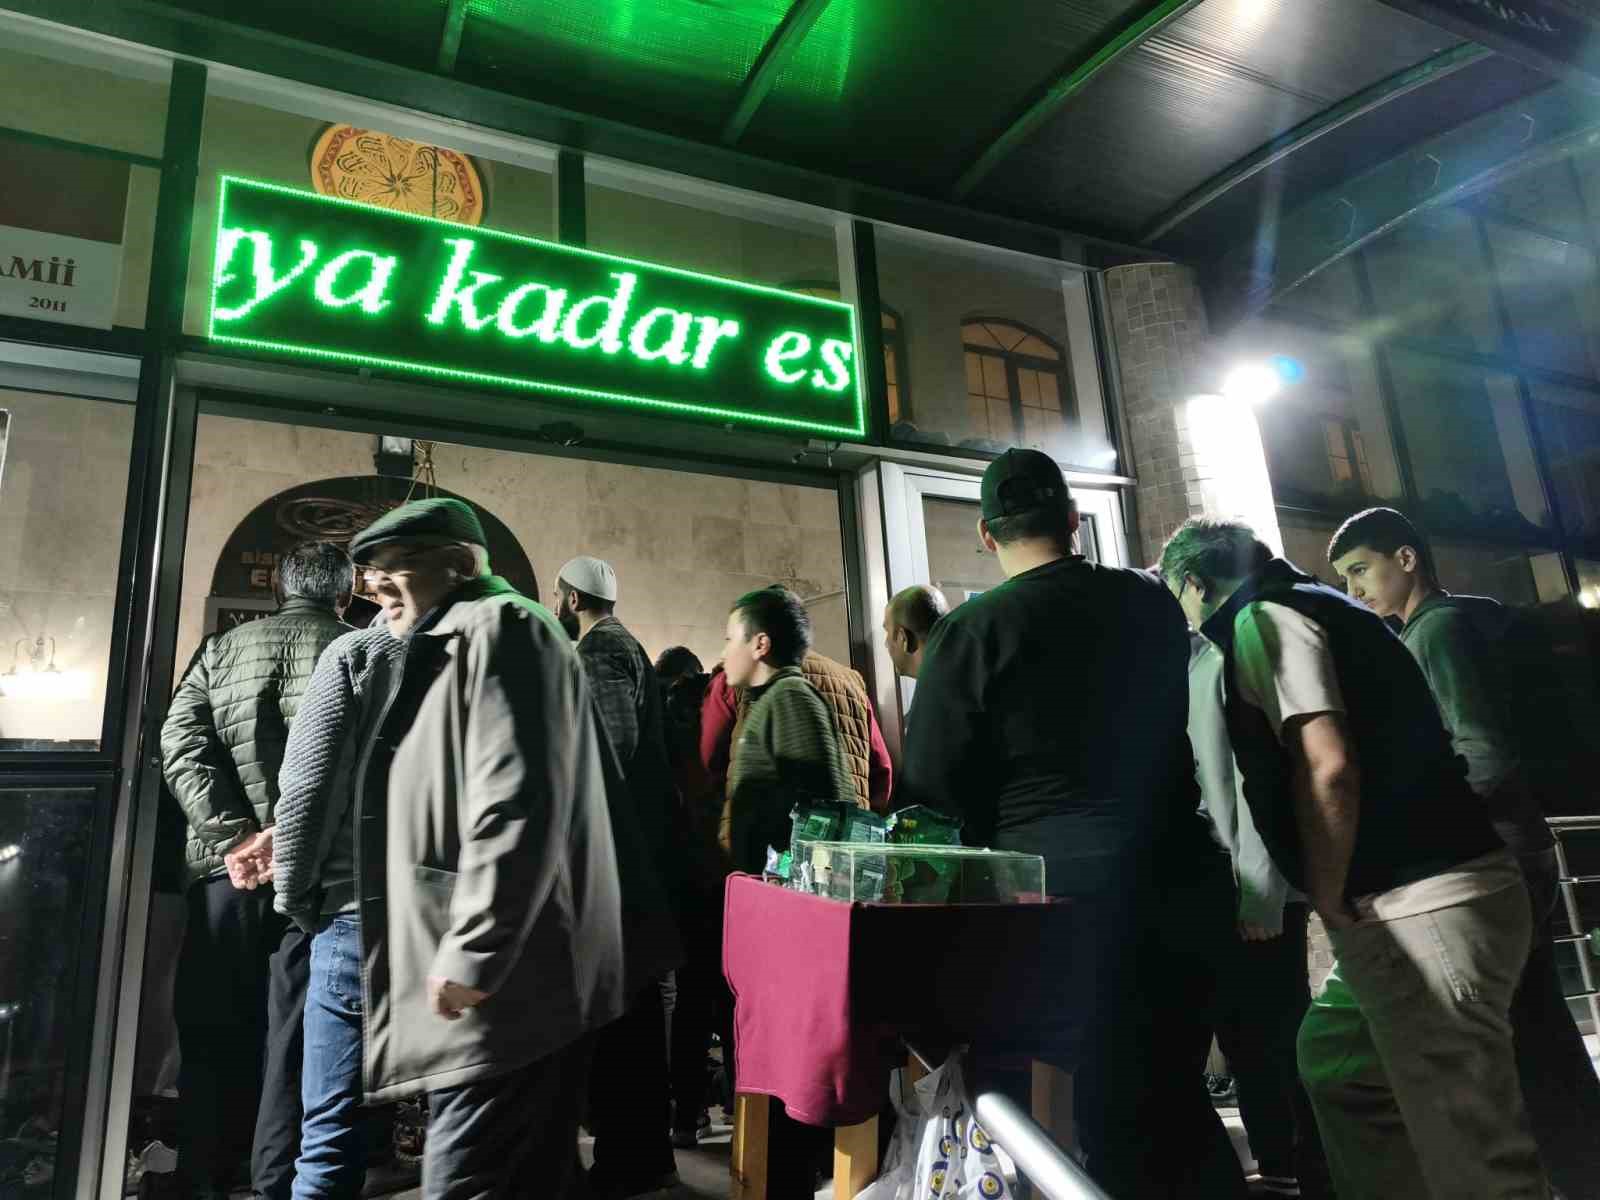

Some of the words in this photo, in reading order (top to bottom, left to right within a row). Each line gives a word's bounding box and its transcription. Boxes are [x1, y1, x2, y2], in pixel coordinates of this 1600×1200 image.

[28, 296, 67, 313] 2011
[424, 237, 739, 369] kadar
[763, 330, 852, 392] es
